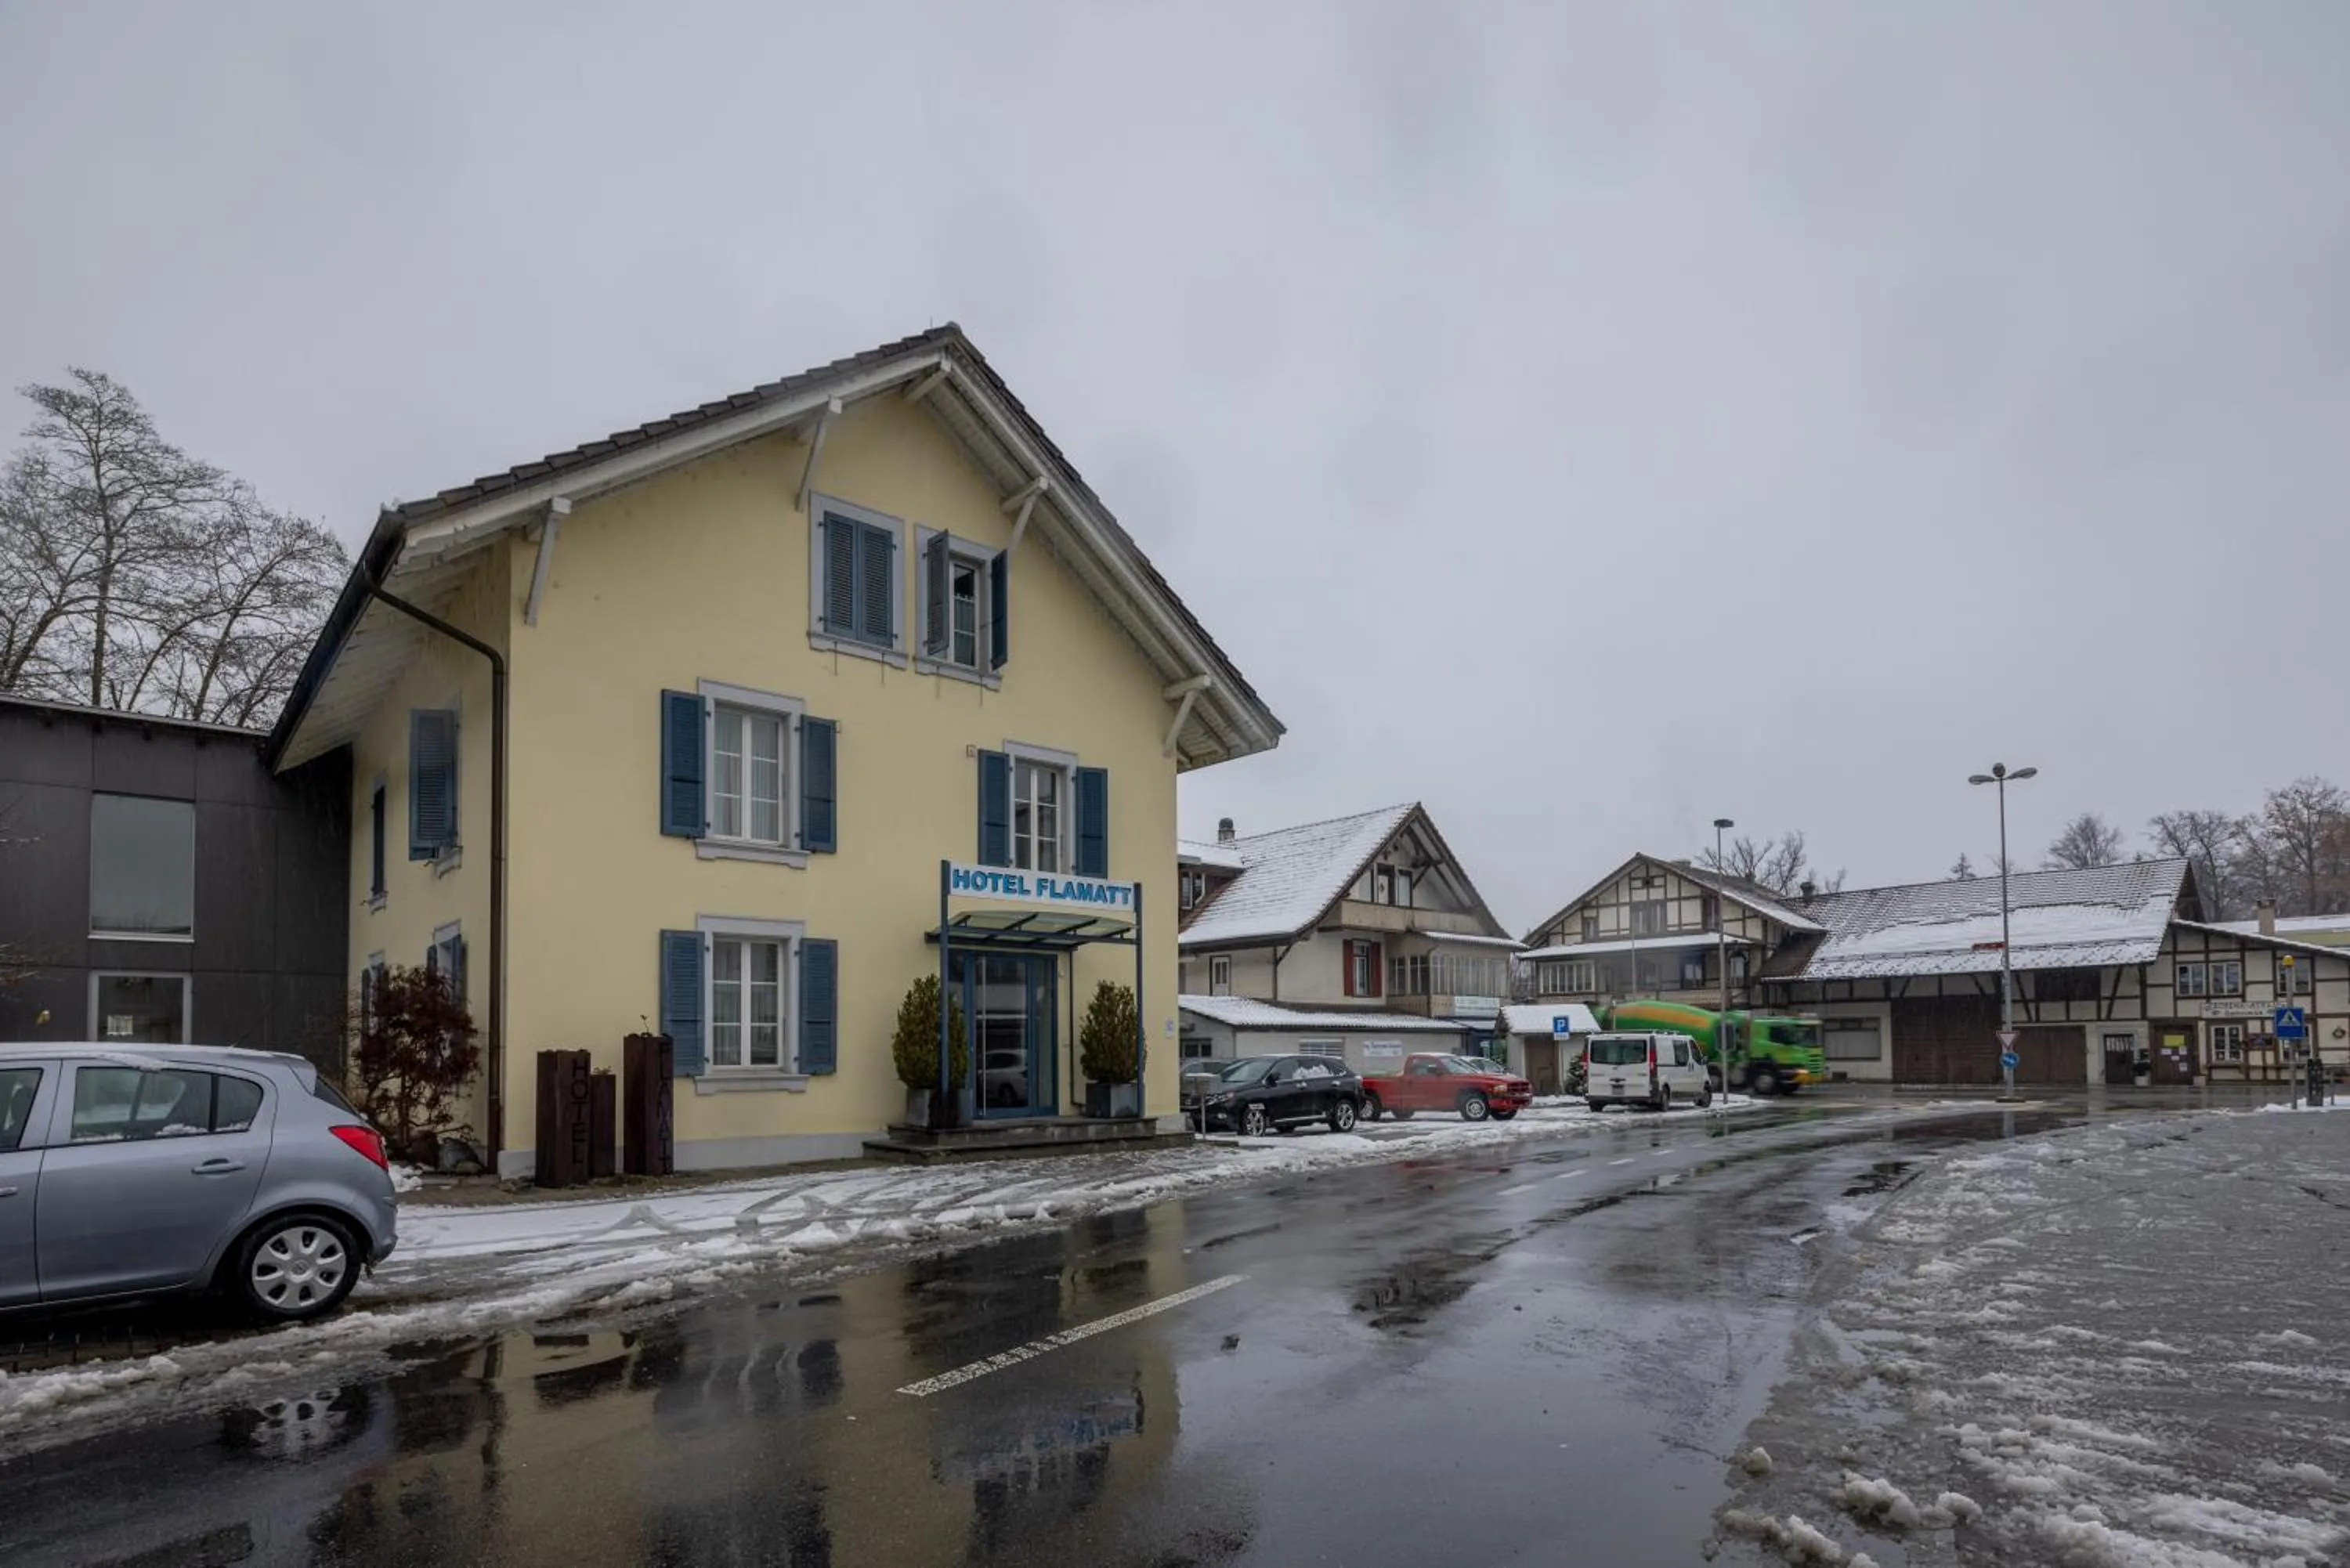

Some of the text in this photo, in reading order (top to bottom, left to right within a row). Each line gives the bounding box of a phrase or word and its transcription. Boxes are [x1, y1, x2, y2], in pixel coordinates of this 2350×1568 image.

[952, 869, 1132, 905] HOTEL FLAMATT
[570, 1057, 590, 1165] HOTEL
